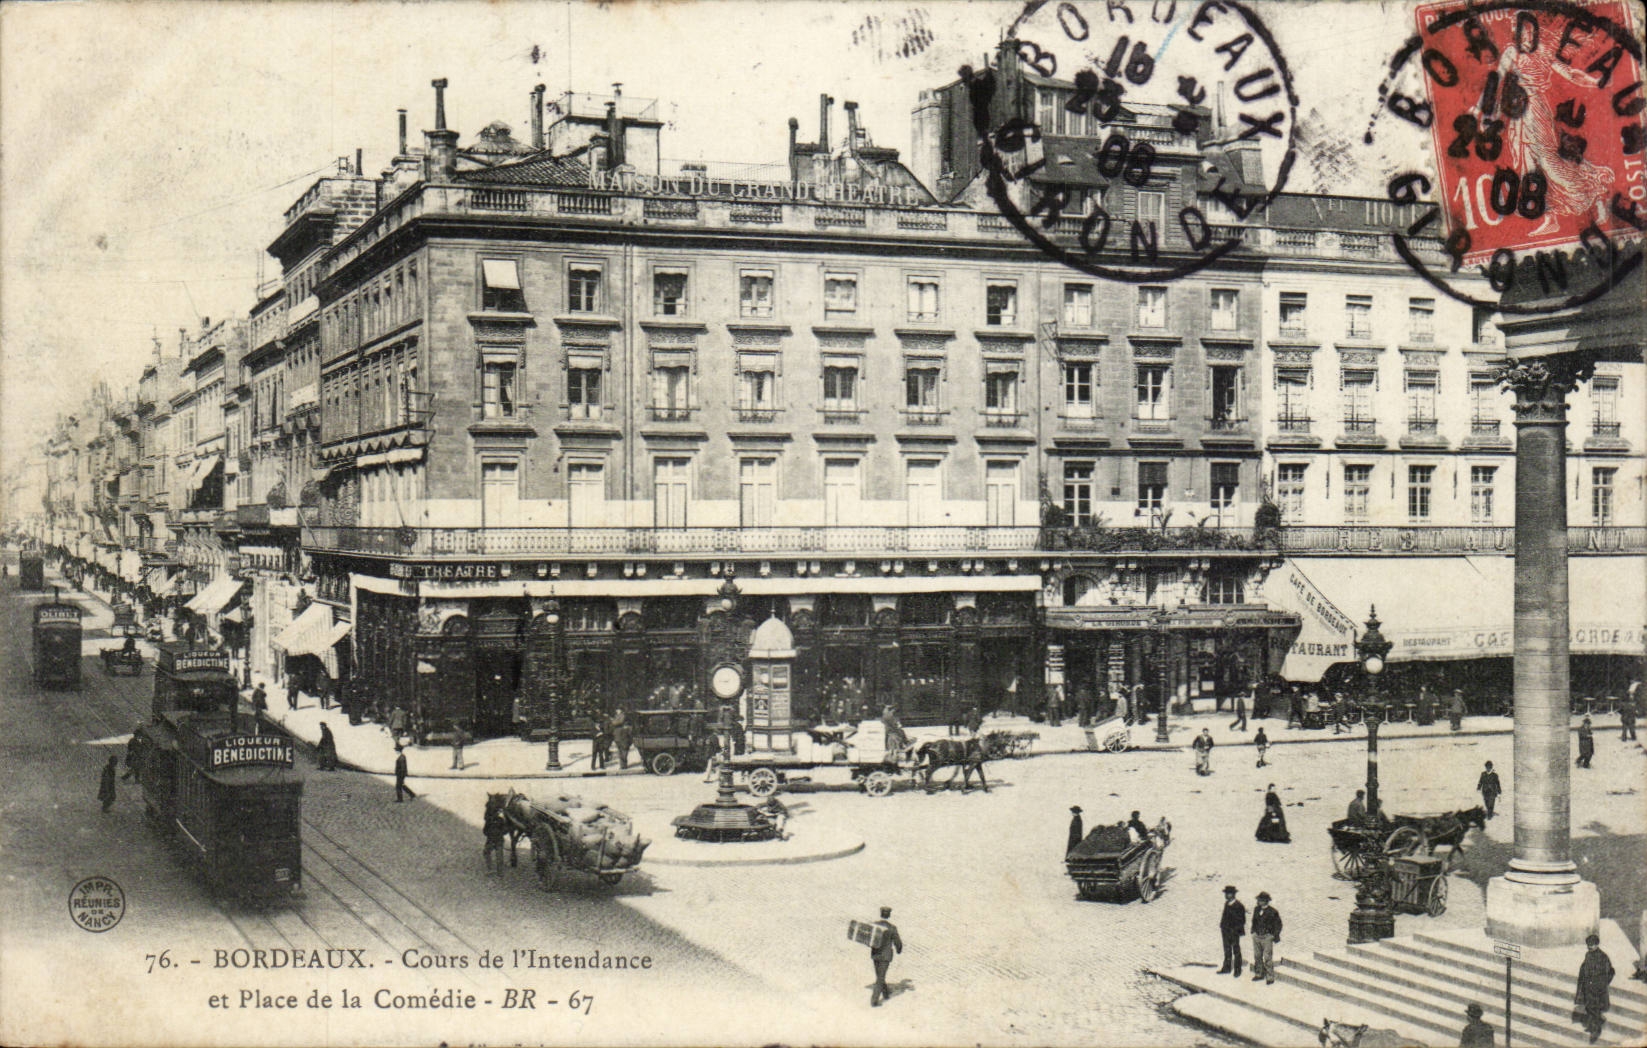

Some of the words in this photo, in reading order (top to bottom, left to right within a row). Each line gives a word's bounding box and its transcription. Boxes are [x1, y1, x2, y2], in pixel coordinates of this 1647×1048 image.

[588, 170, 680, 194] MAISON
[689, 174, 721, 196] DU
[731, 176, 810, 199] GRAND
[421, 565, 497, 579] THEATRE
[183, 651, 221, 659] LIQUEUR
[225, 737, 281, 747] LIQUEUR
